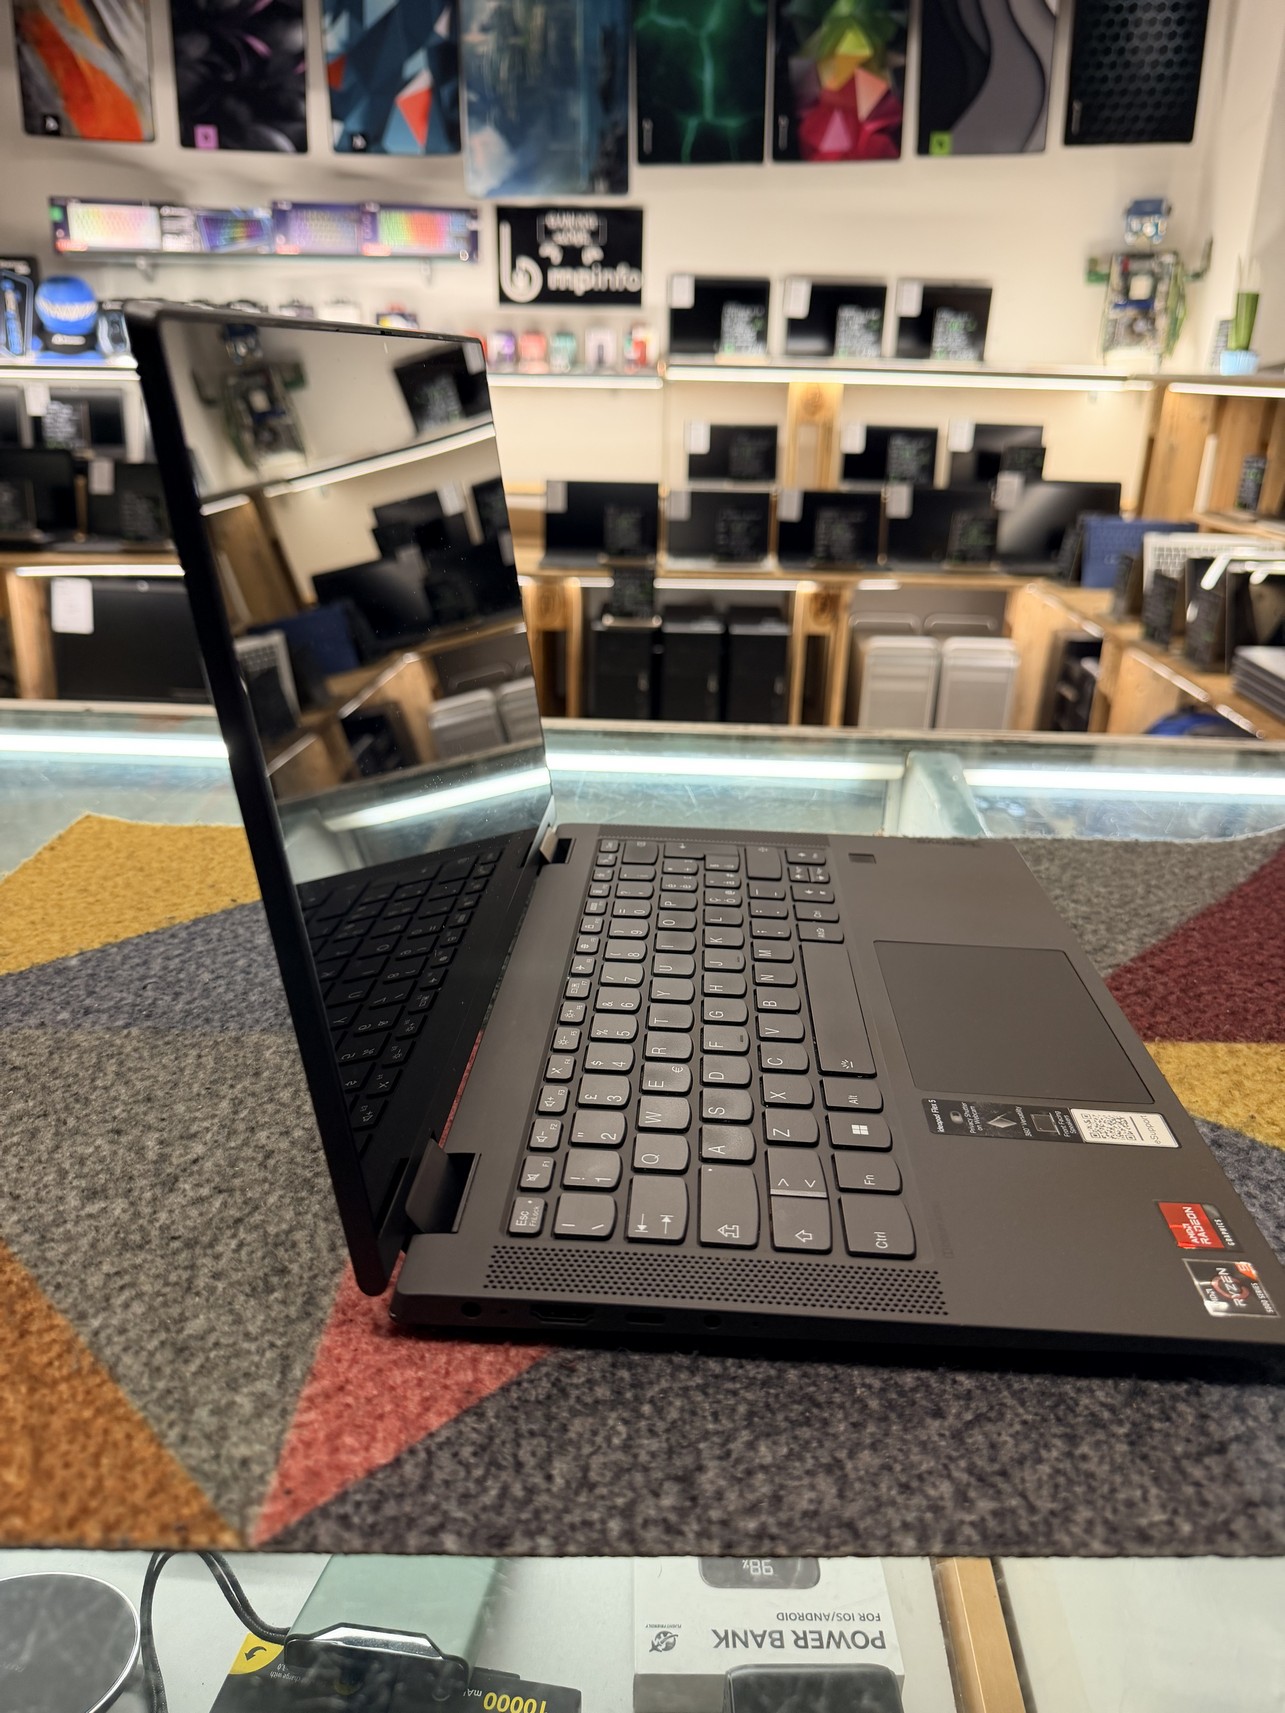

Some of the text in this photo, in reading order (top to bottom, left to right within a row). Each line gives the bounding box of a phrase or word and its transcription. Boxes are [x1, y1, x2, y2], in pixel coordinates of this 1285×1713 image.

[758, 949, 772, 957] M
[709, 984, 723, 992] H
[765, 1027, 780, 1035] V
[651, 1047, 666, 1055] R
[767, 1057, 783, 1066] C
[708, 1072, 724, 1080] D
[648, 1080, 664, 1088] E
[770, 1091, 786, 1100] X
[848, 1095, 859, 1105] Alt
[708, 1107, 725, 1115] S
[970, 1106, 980, 1124] Webcam
[645, 1111, 662, 1123] W
[961, 1102, 977, 1134] Privacy Shutter
[1054, 1110, 1071, 1138] Front Facing
[1063, 1114, 1077, 1134] Speakers
[600, 1132, 617, 1140] 2
[772, 1128, 790, 1137] Z
[708, 1145, 726, 1155] A
[641, 1154, 660, 1164] Q
[864, 1174, 875, 1186] Fn
[1182, 1206, 1212, 1245] RADEON
[1214, 1219, 1236, 1246] GRAPHICS
[874, 1232, 888, 1249] Ctrl
[1216, 1267, 1247, 1307] RYZEN
[858, 1612, 881, 1622] FOR
[711, 1629, 886, 1650] POWER BANK
[269, 1671, 282, 1679] with
[483, 1692, 548, 1713] 10000
